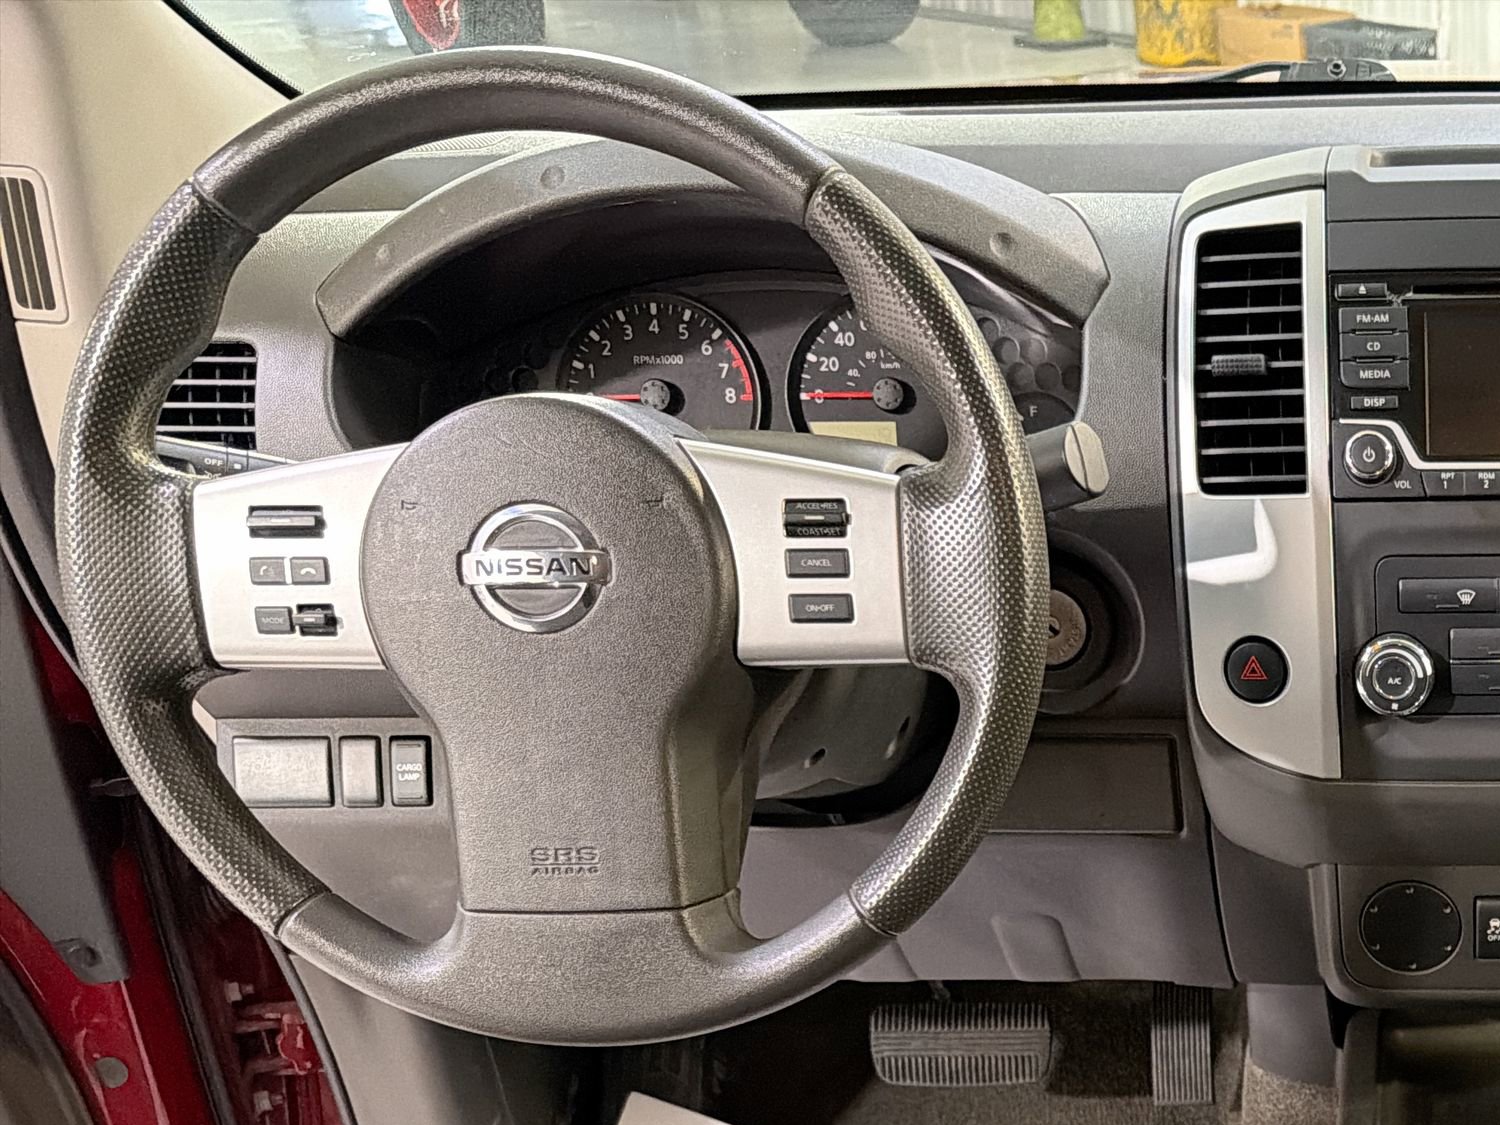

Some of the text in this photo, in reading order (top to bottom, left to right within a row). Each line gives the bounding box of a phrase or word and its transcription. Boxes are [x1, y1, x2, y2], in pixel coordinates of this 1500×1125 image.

[648, 319, 660, 334] 4
[623, 325, 633, 340] 3
[678, 324, 689, 340] 5
[834, 331, 855, 347] 40
[601, 340, 612, 356] 2
[701, 340, 713, 356] 6
[1366, 341, 1381, 351] CD
[865, 351, 877, 360] 80
[819, 356, 839, 372] 20
[880, 361, 901, 369] km/h
[588, 363, 595, 379] 1
[718, 363, 729, 379] 7
[847, 368, 859, 377] 40
[1359, 369, 1391, 379] MEDIA
[724, 387, 737, 404] 8
[1363, 398, 1386, 407] DISP
[1030, 405, 1038, 417] F
[204, 457, 223, 467] OFF
[1441, 472, 1455, 480] RPT
[1478, 472, 1496, 480] RDM
[1394, 480, 1411, 489] VOL
[1443, 480, 1448, 489] 1
[1483, 480, 1489, 489] 2
[475, 557, 594, 577] NISSAN
[801, 559, 833, 567] CANCEL
[1387, 676, 1402, 685] A/C
[396, 763, 422, 772] CARGO
[398, 772, 421, 782] LAMP
[530, 847, 599, 862] SRS
[530, 866, 600, 876] AIRBAG
